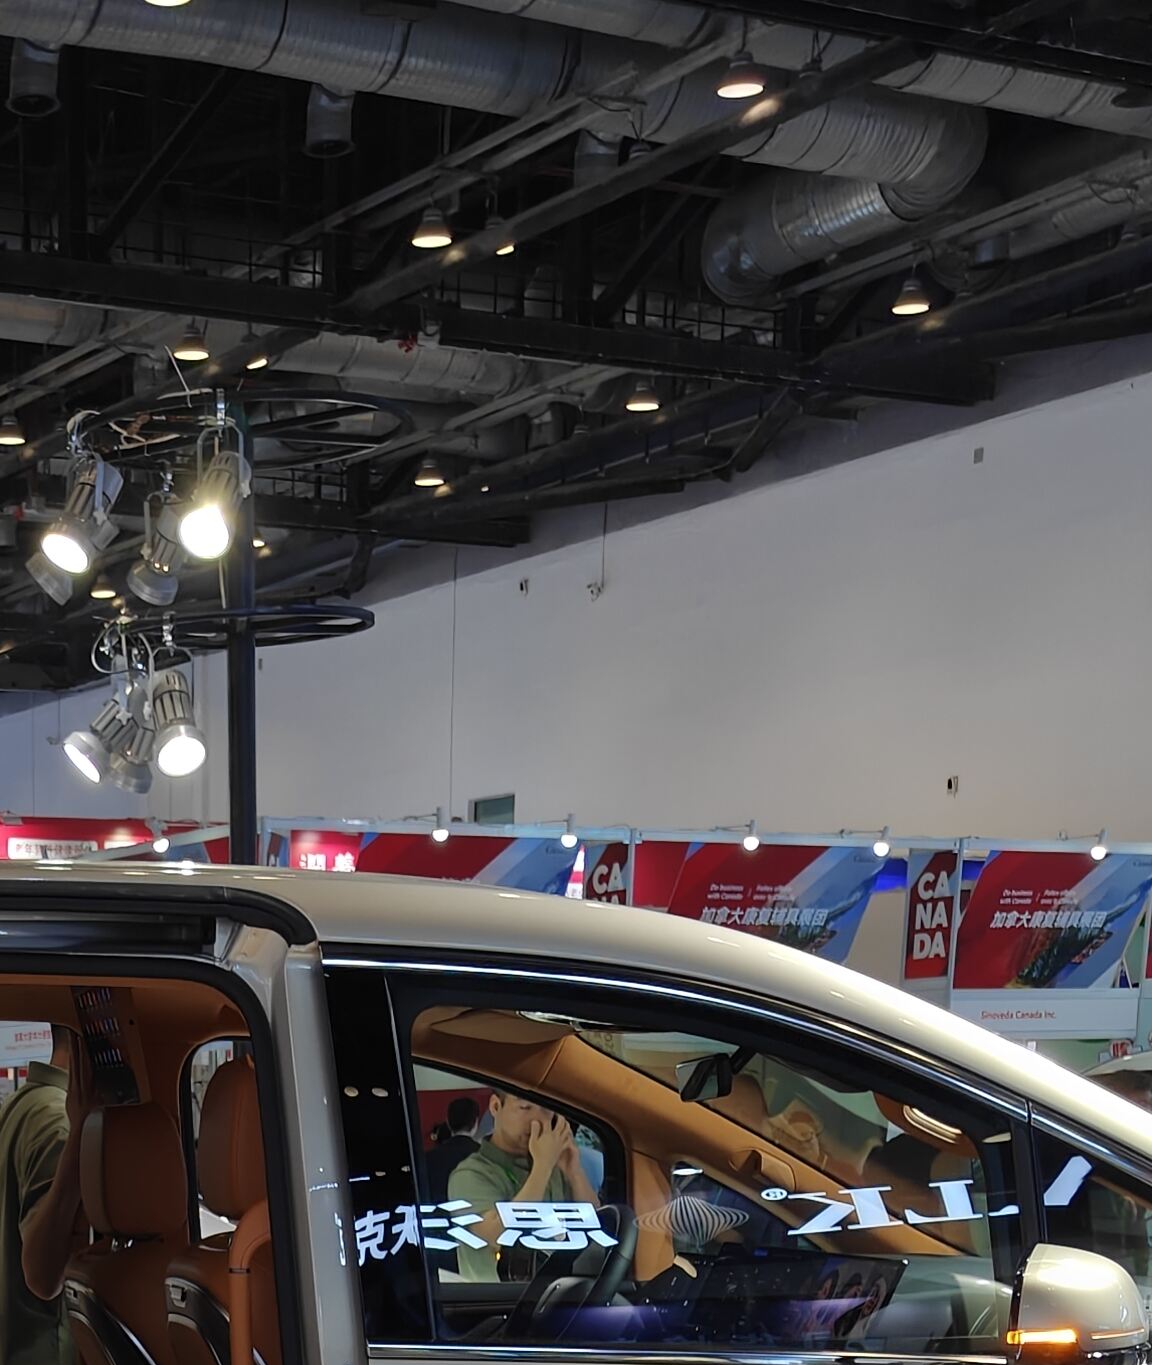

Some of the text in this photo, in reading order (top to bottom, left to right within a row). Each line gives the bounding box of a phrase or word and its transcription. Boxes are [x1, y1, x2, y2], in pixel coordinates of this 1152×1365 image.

[592, 862, 625, 895] CA
[917, 871, 951, 900] CA
[915, 901, 948, 930] NA
[912, 930, 946, 960] DA
[1015, 1010, 1043, 1020] Canada
